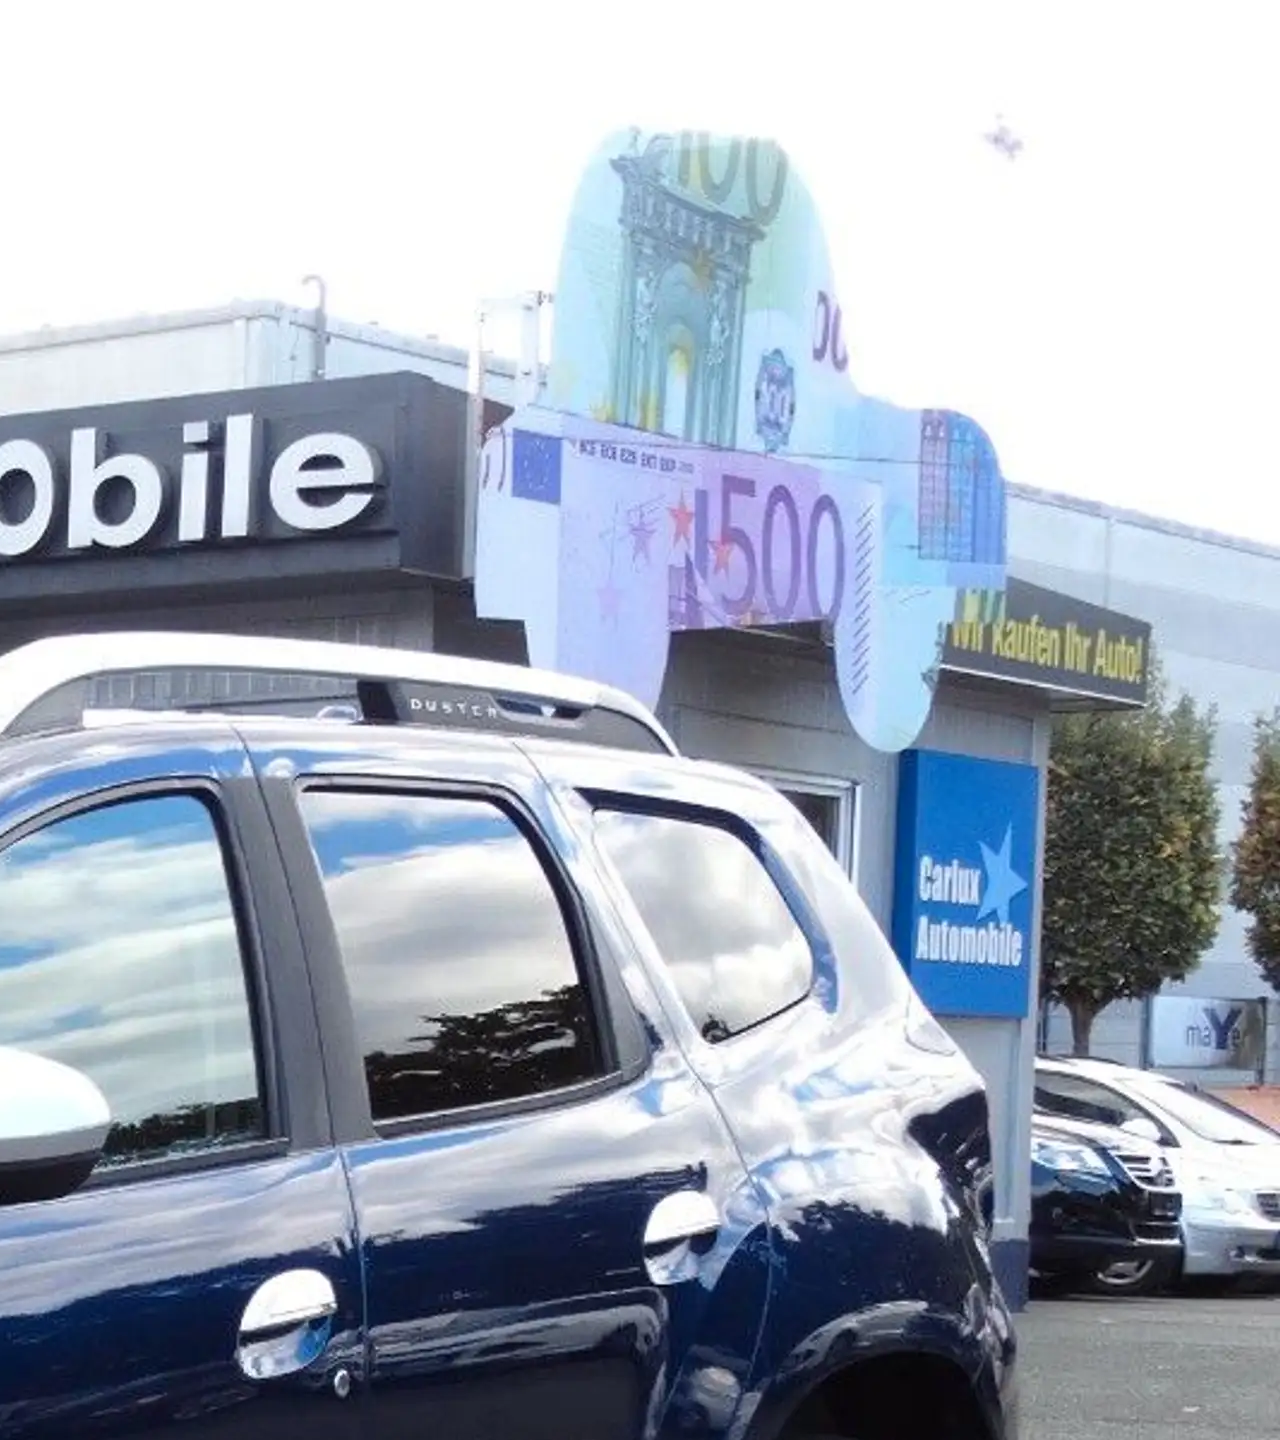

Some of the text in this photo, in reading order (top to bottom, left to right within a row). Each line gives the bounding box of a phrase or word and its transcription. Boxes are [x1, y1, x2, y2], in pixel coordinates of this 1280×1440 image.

[720, 474, 845, 618] 500
[1093, 627, 1144, 684] Auto!
[410, 698, 497, 718] DUSTER
[919, 855, 982, 907] Carlux
[915, 915, 1023, 967] Automobile
